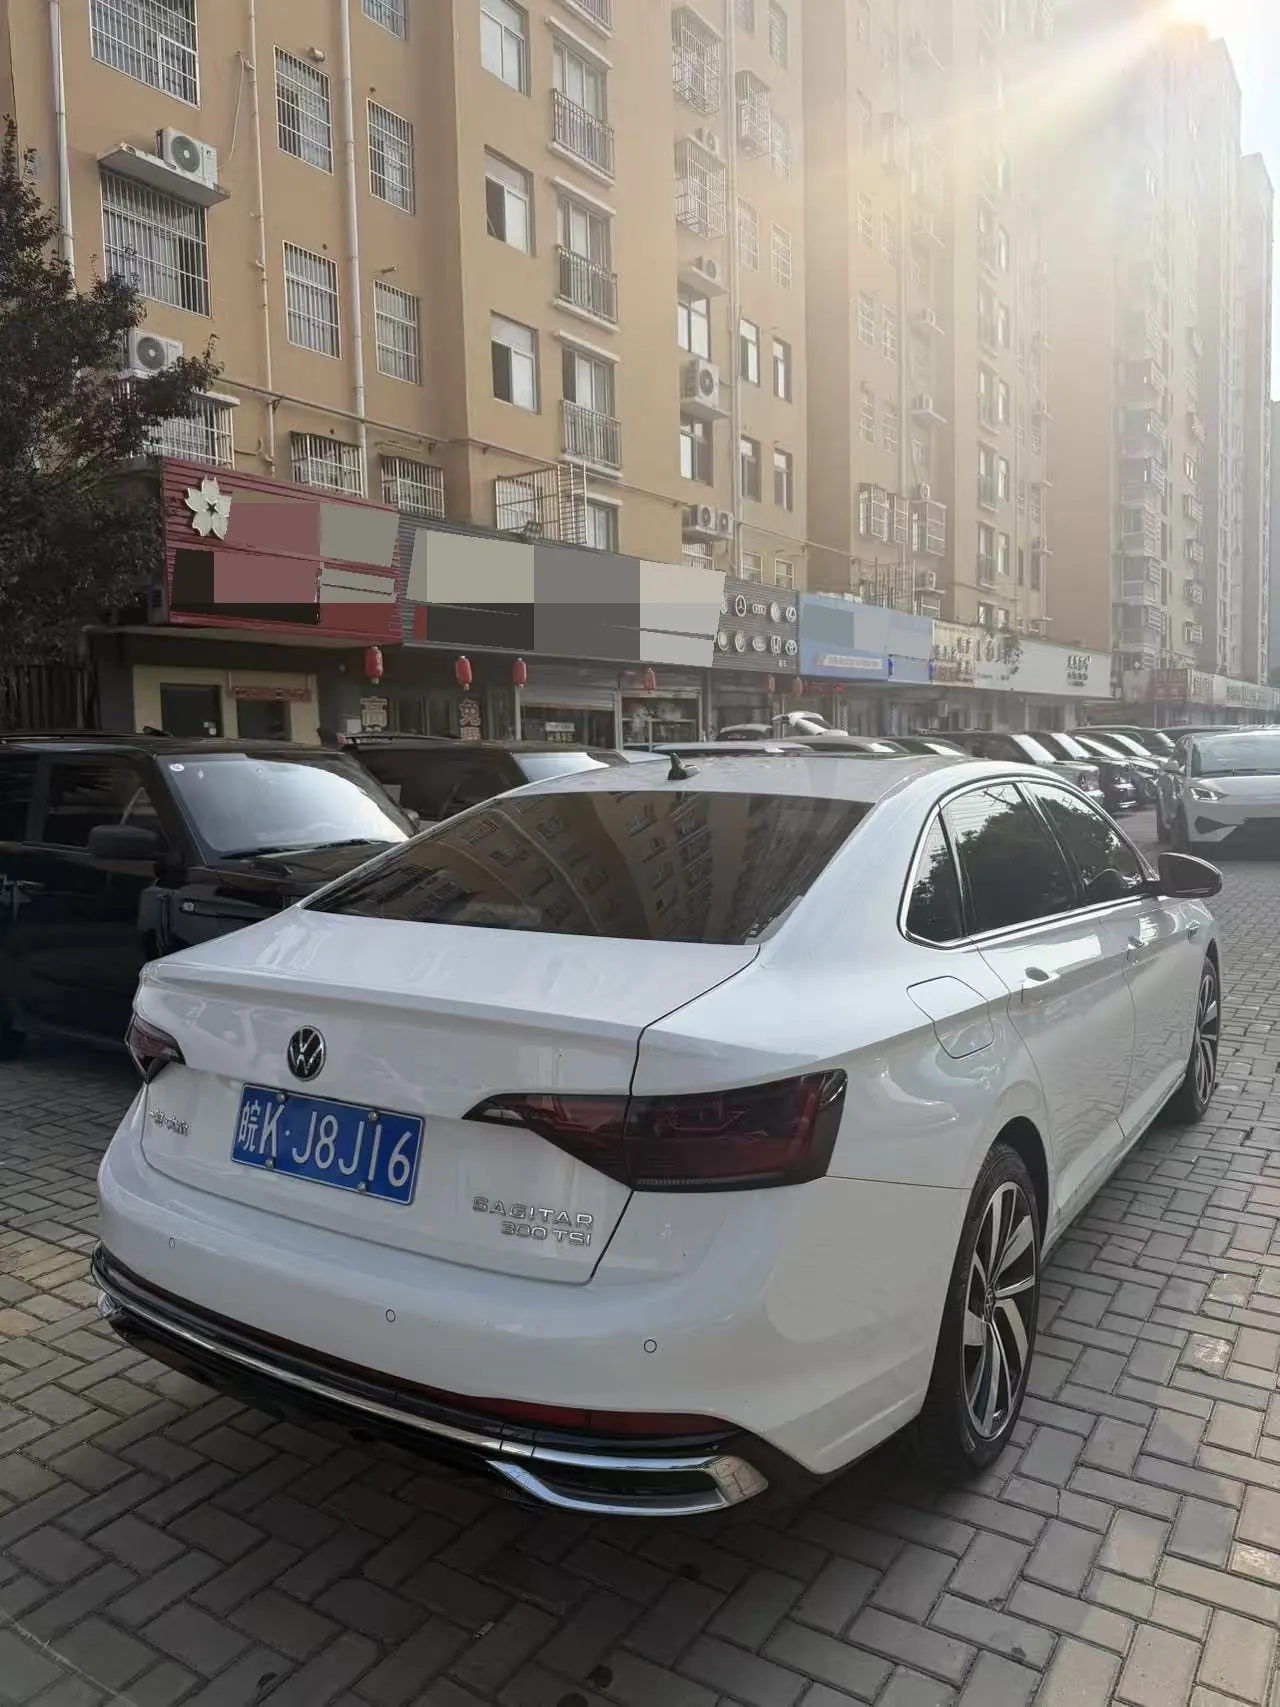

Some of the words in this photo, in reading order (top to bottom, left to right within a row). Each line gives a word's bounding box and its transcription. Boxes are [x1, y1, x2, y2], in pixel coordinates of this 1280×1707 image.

[359, 696, 388, 733] 高
[471, 1195, 594, 1230] SAGITAR
[501, 1220, 548, 1241] 300
[552, 1226, 592, 1247] TSI
